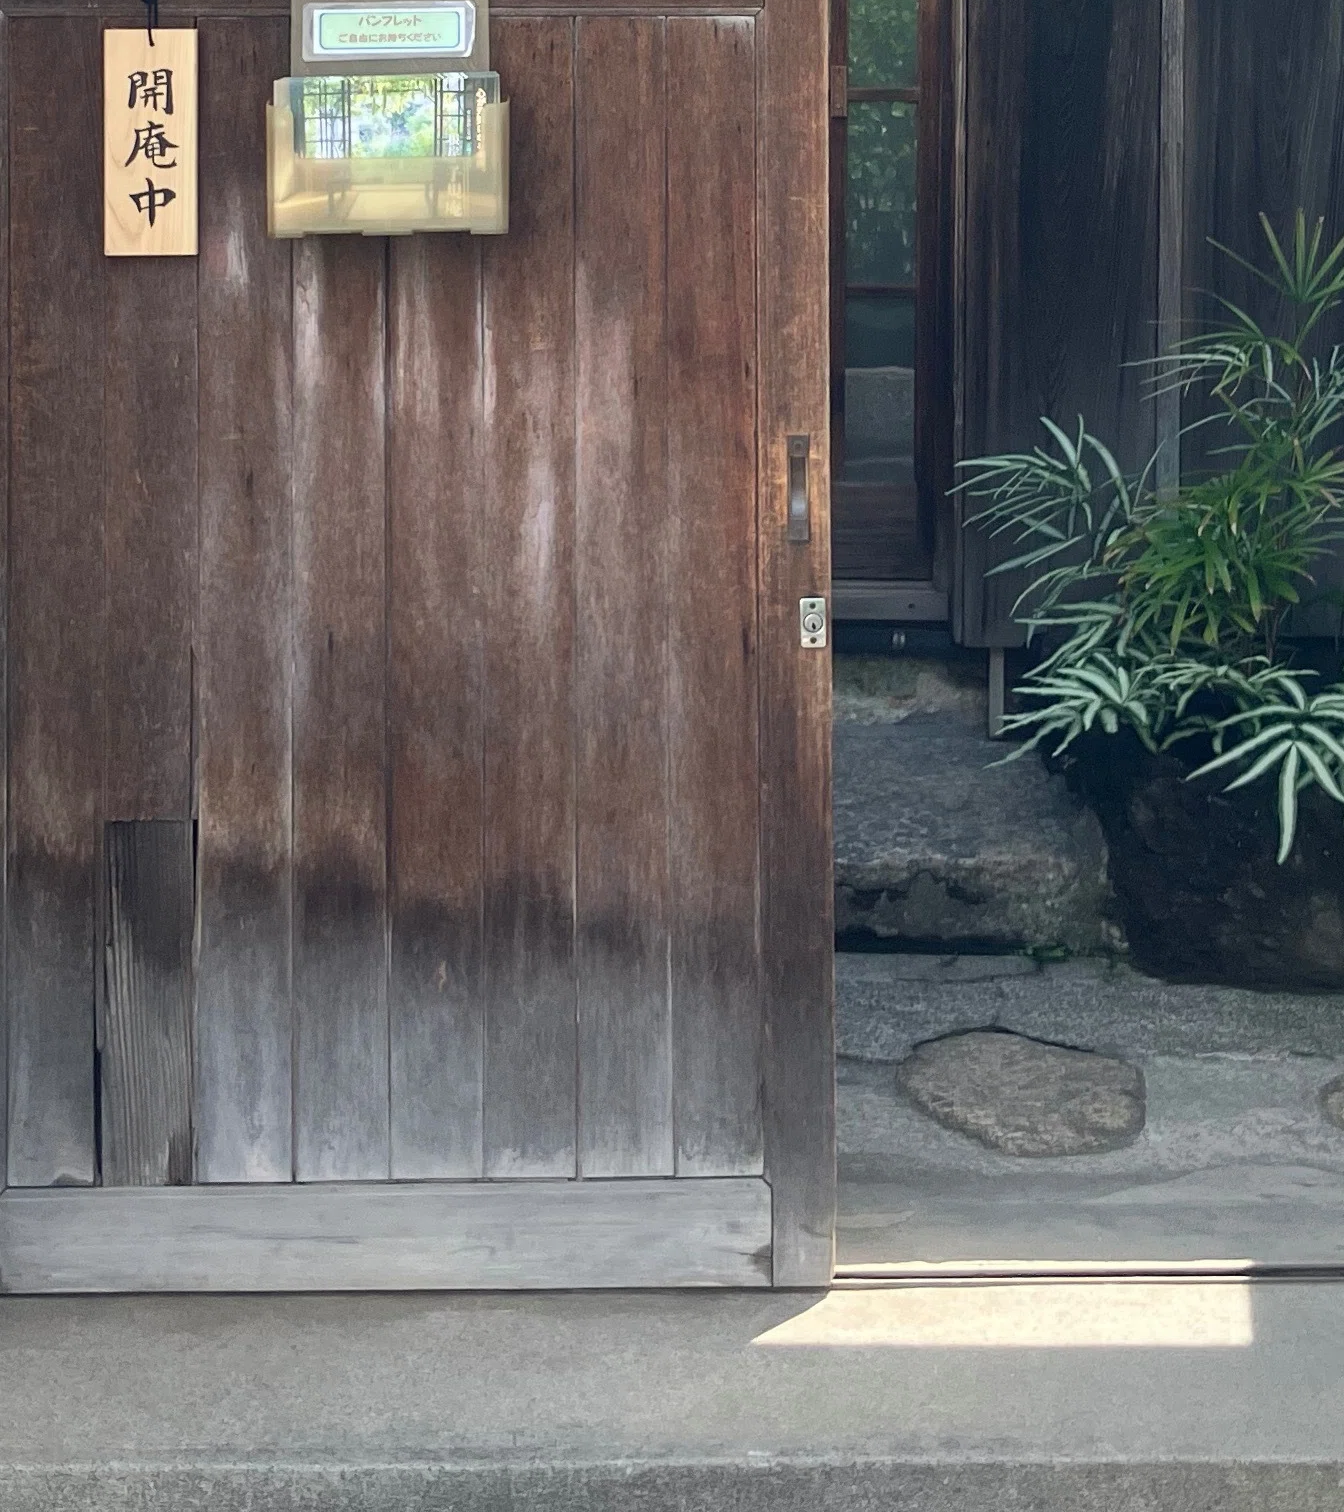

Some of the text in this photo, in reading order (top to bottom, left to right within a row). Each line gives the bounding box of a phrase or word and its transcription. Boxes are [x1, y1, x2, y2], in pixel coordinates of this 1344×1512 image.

[358, 14, 423, 27] パンフレット
[337, 32, 442, 44] ご自由にお持ちください
[124, 68, 180, 228] 開庵中
